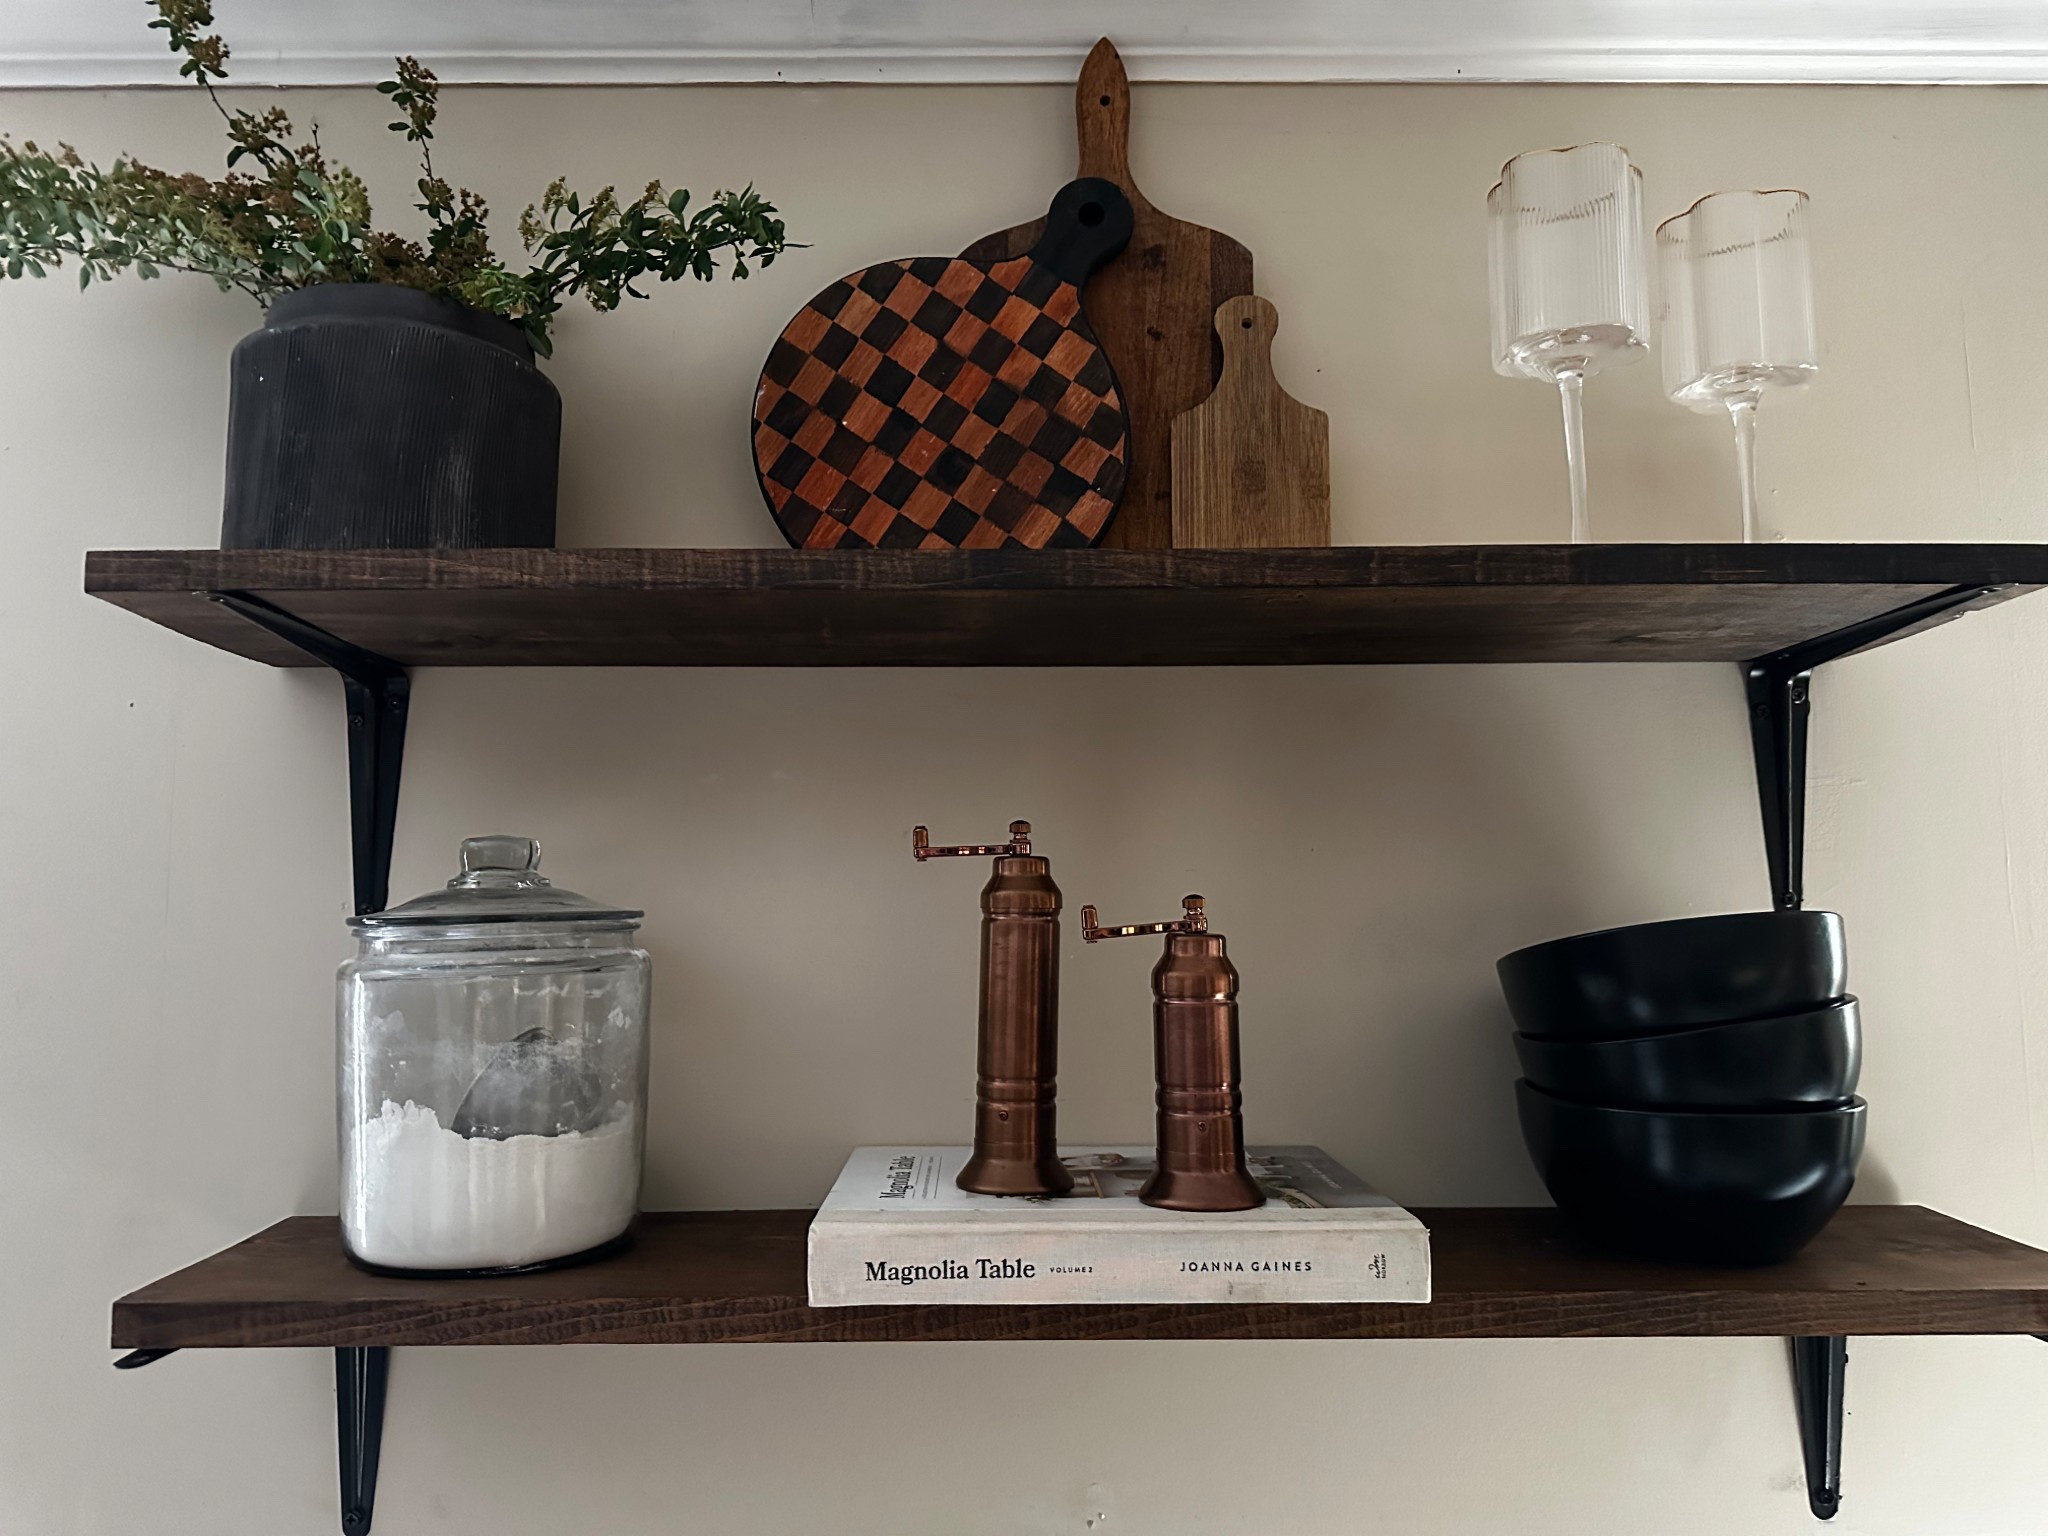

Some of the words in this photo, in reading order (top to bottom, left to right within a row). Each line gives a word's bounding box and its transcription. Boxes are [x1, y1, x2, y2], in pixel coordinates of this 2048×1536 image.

[889, 1155, 916, 1171] Table
[878, 1171, 914, 1199] Magnolia
[865, 1260, 970, 1286] Magnolia
[975, 1257, 1036, 1279] Table
[1049, 1266, 1086, 1274] VOLUME
[1180, 1261, 1245, 1272] JOANNA
[1250, 1261, 1312, 1272] GAINES
